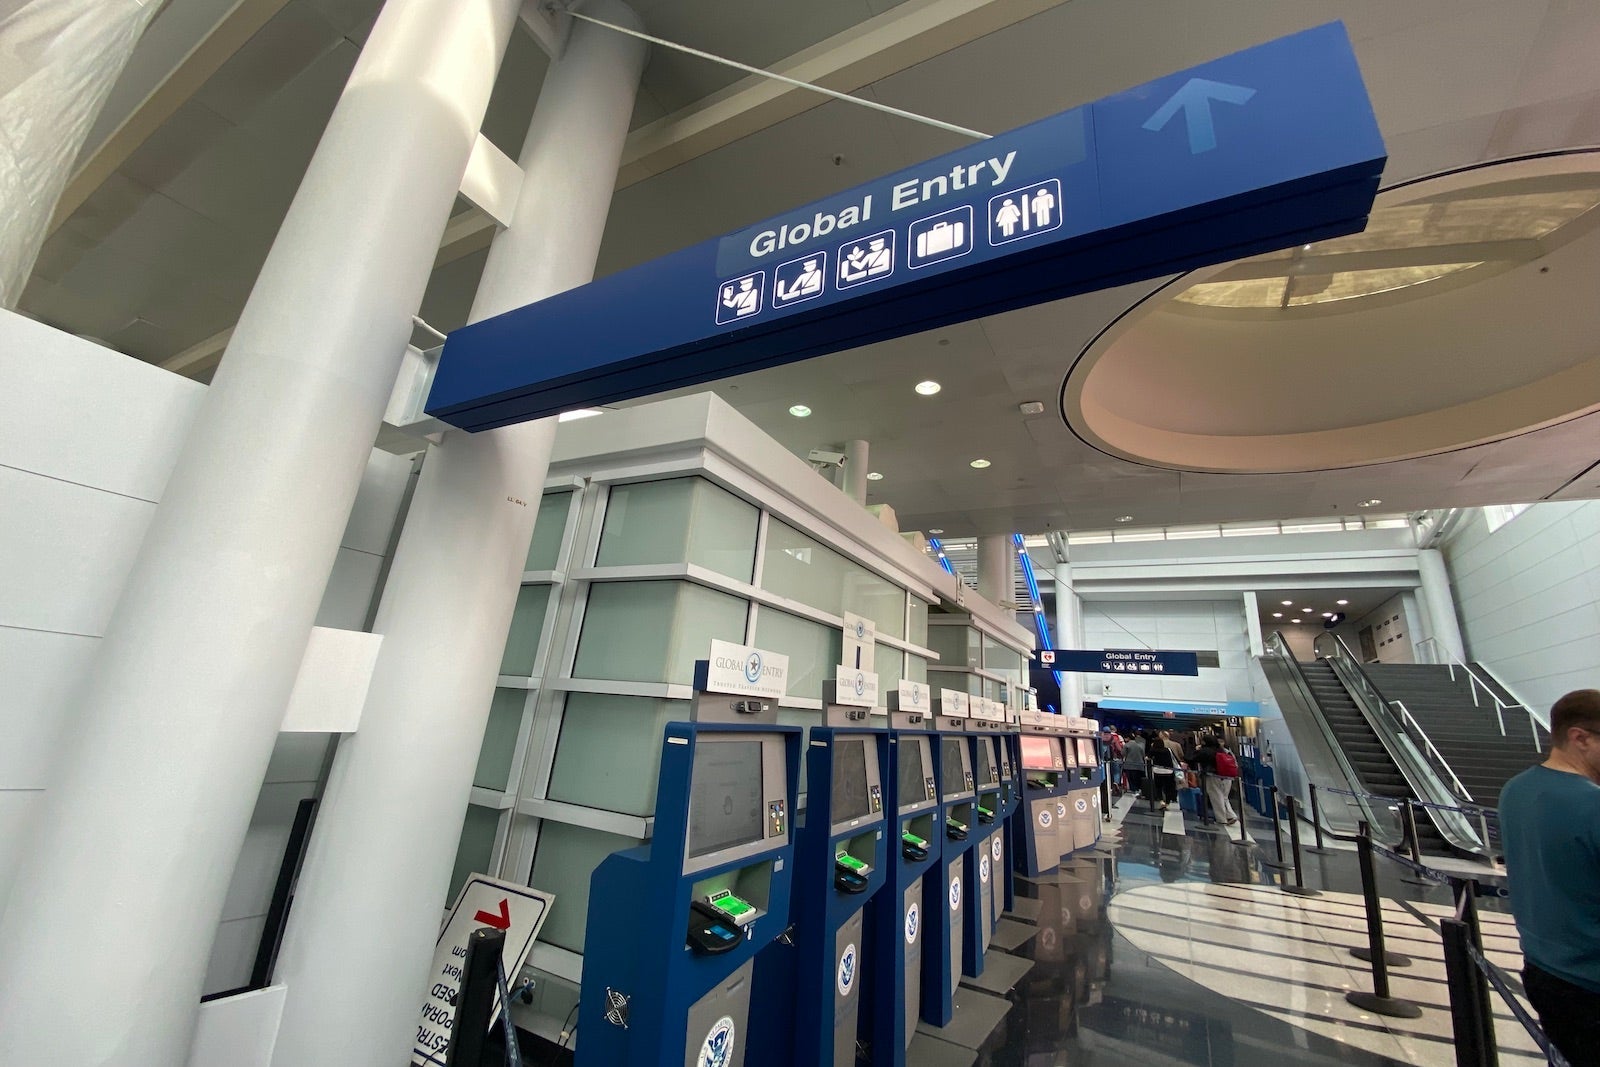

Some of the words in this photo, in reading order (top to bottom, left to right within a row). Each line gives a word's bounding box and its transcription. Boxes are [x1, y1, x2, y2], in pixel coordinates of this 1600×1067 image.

[749, 194, 872, 258] Global
[891, 150, 1017, 211] Entry
[715, 656, 744, 672] GLOBAL
[762, 665, 784, 678] ENTRY
[1105, 652, 1132, 660] Global
[1134, 653, 1156, 661] Entry
[431, 983, 457, 1003] SED
